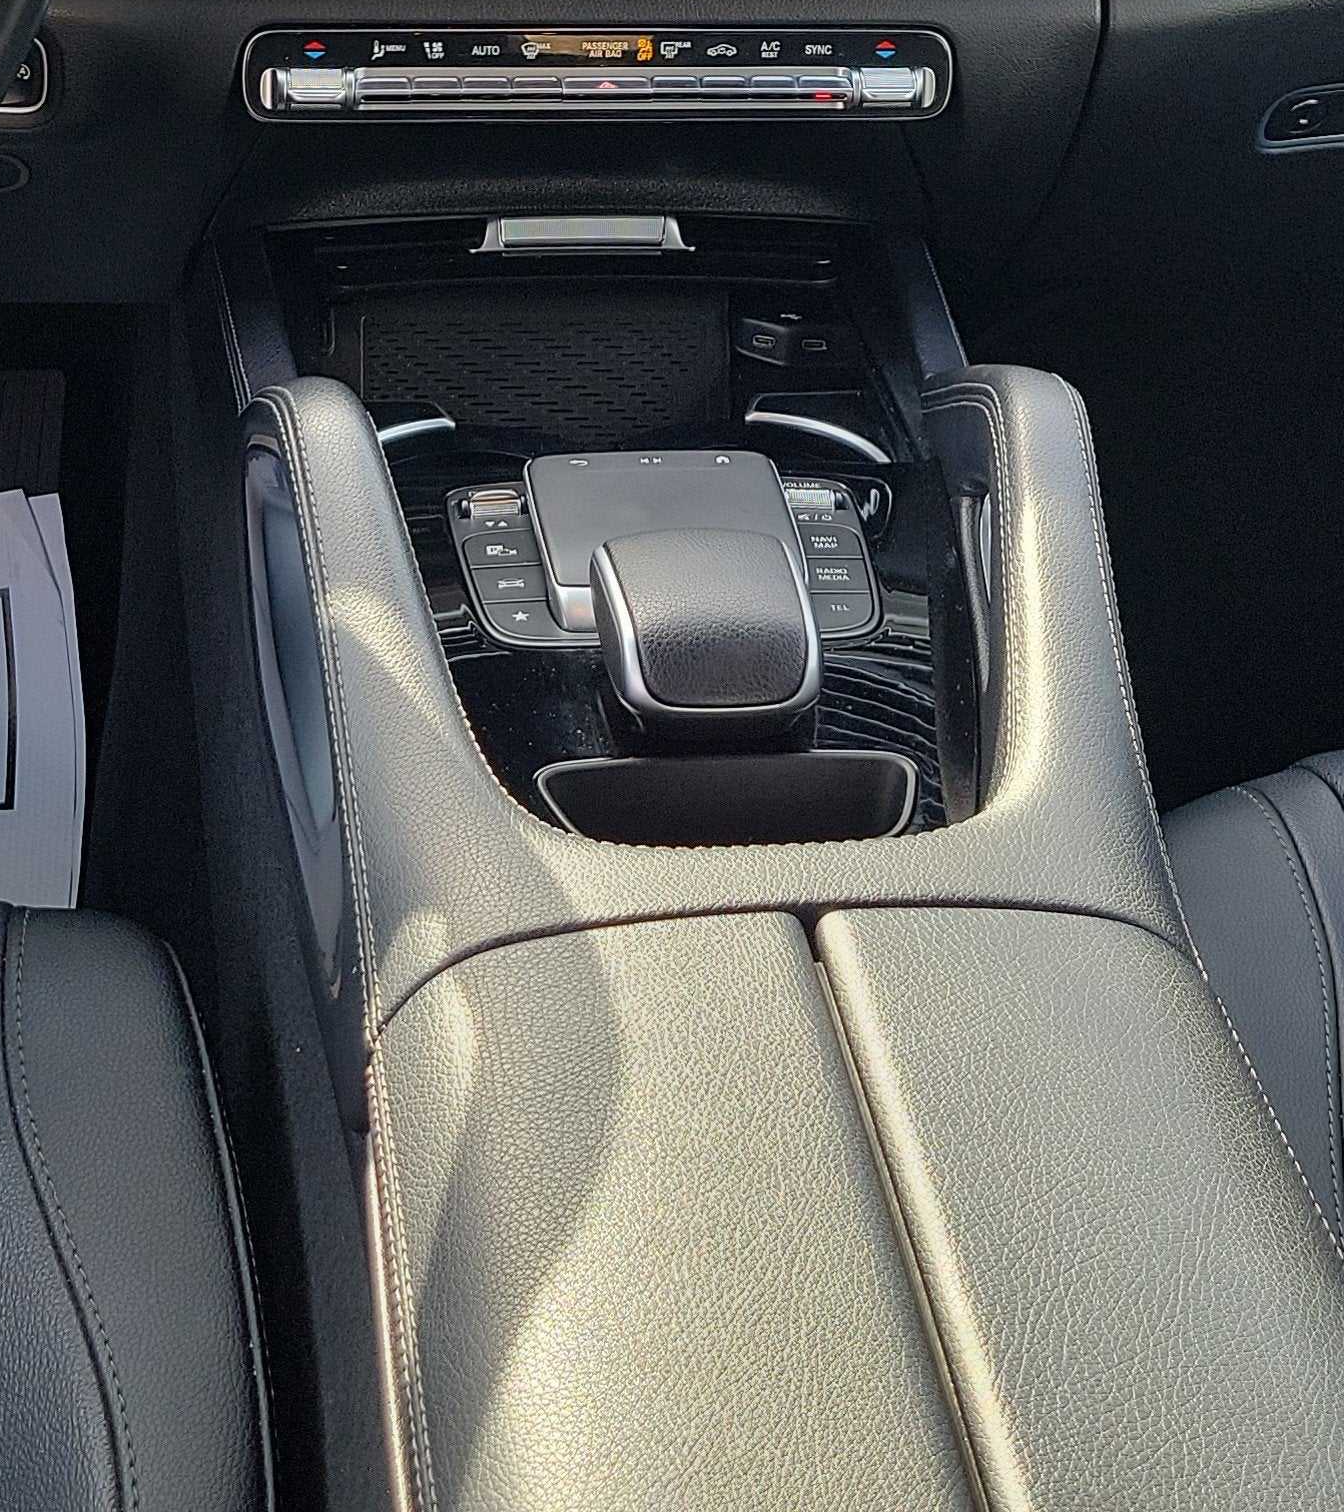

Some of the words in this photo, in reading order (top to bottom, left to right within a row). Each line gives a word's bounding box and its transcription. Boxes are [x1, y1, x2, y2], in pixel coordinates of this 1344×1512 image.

[386, 44, 406, 52] MENU
[582, 42, 629, 50] PASSENGER
[760, 41, 781, 51] A/C
[805, 44, 833, 55] SYNC
[471, 45, 500, 56] AUTO
[589, 50, 603, 58] AIR
[605, 50, 622, 58] BAG
[637, 52, 653, 61] OFF
[830, 604, 850, 612] TEL
